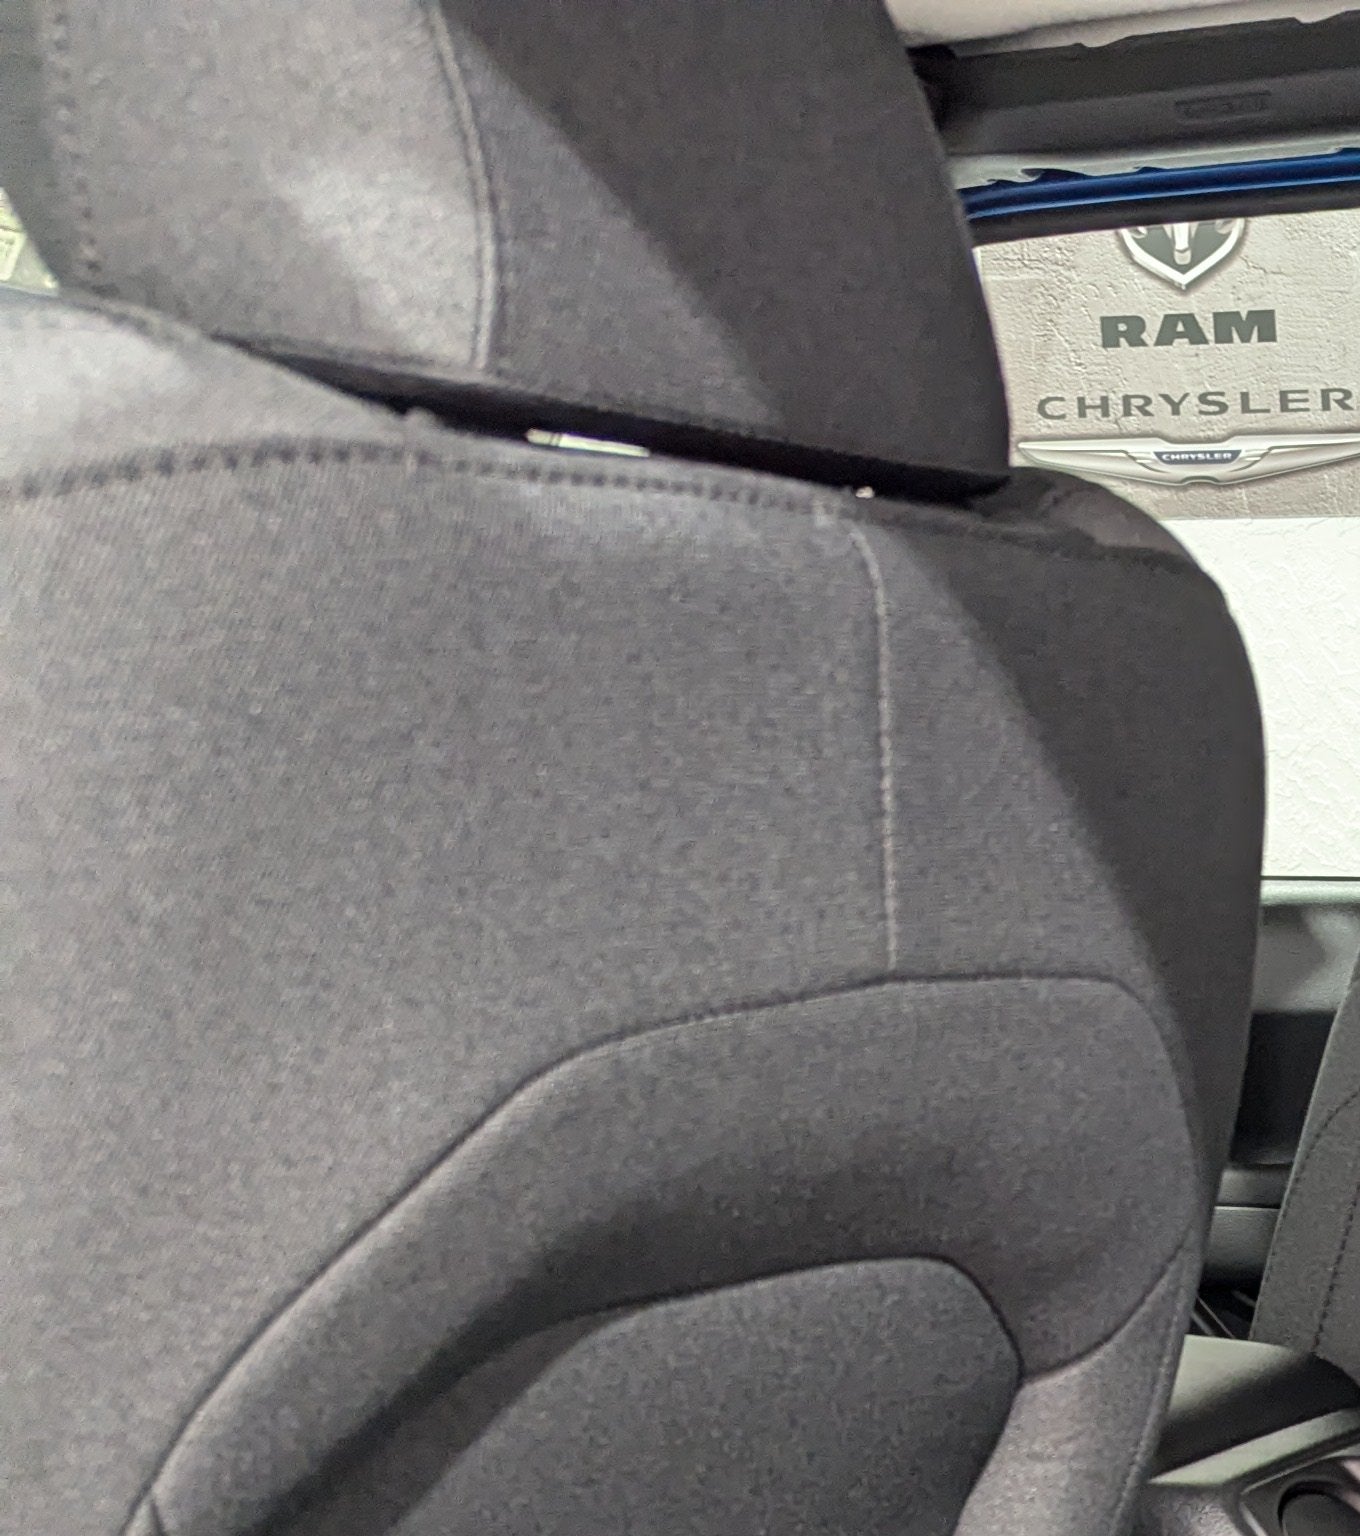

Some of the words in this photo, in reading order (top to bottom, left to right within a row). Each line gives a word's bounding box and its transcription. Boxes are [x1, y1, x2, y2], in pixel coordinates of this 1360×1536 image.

[1100, 309, 1278, 349] RAM
[1036, 387, 1355, 420] CHRYSLER
[1161, 451, 1233, 461] CHRYSLER
